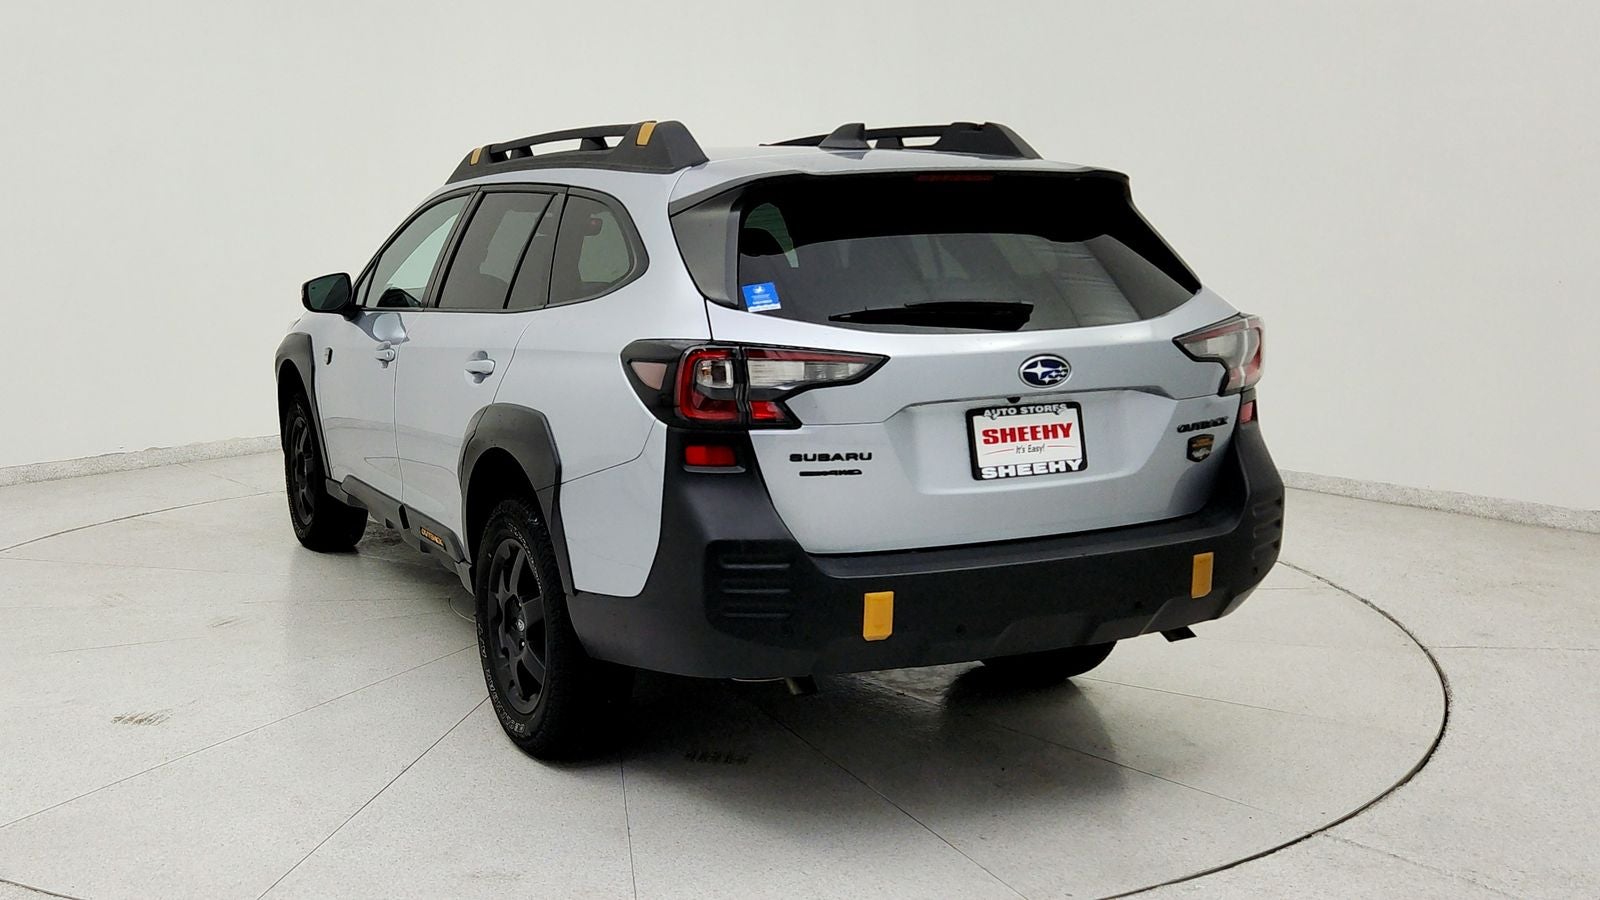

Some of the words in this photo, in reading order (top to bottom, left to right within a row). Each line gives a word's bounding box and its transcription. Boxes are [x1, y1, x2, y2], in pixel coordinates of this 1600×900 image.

[983, 407, 1018, 419] AUTO
[1020, 403, 1068, 415] STORES
[982, 422, 1073, 445] SHEEHY
[1016, 445, 1026, 454] It's
[1027, 443, 1046, 454] Easy!
[789, 452, 873, 463] SUBARU
[981, 459, 1083, 480] SHEEHY
